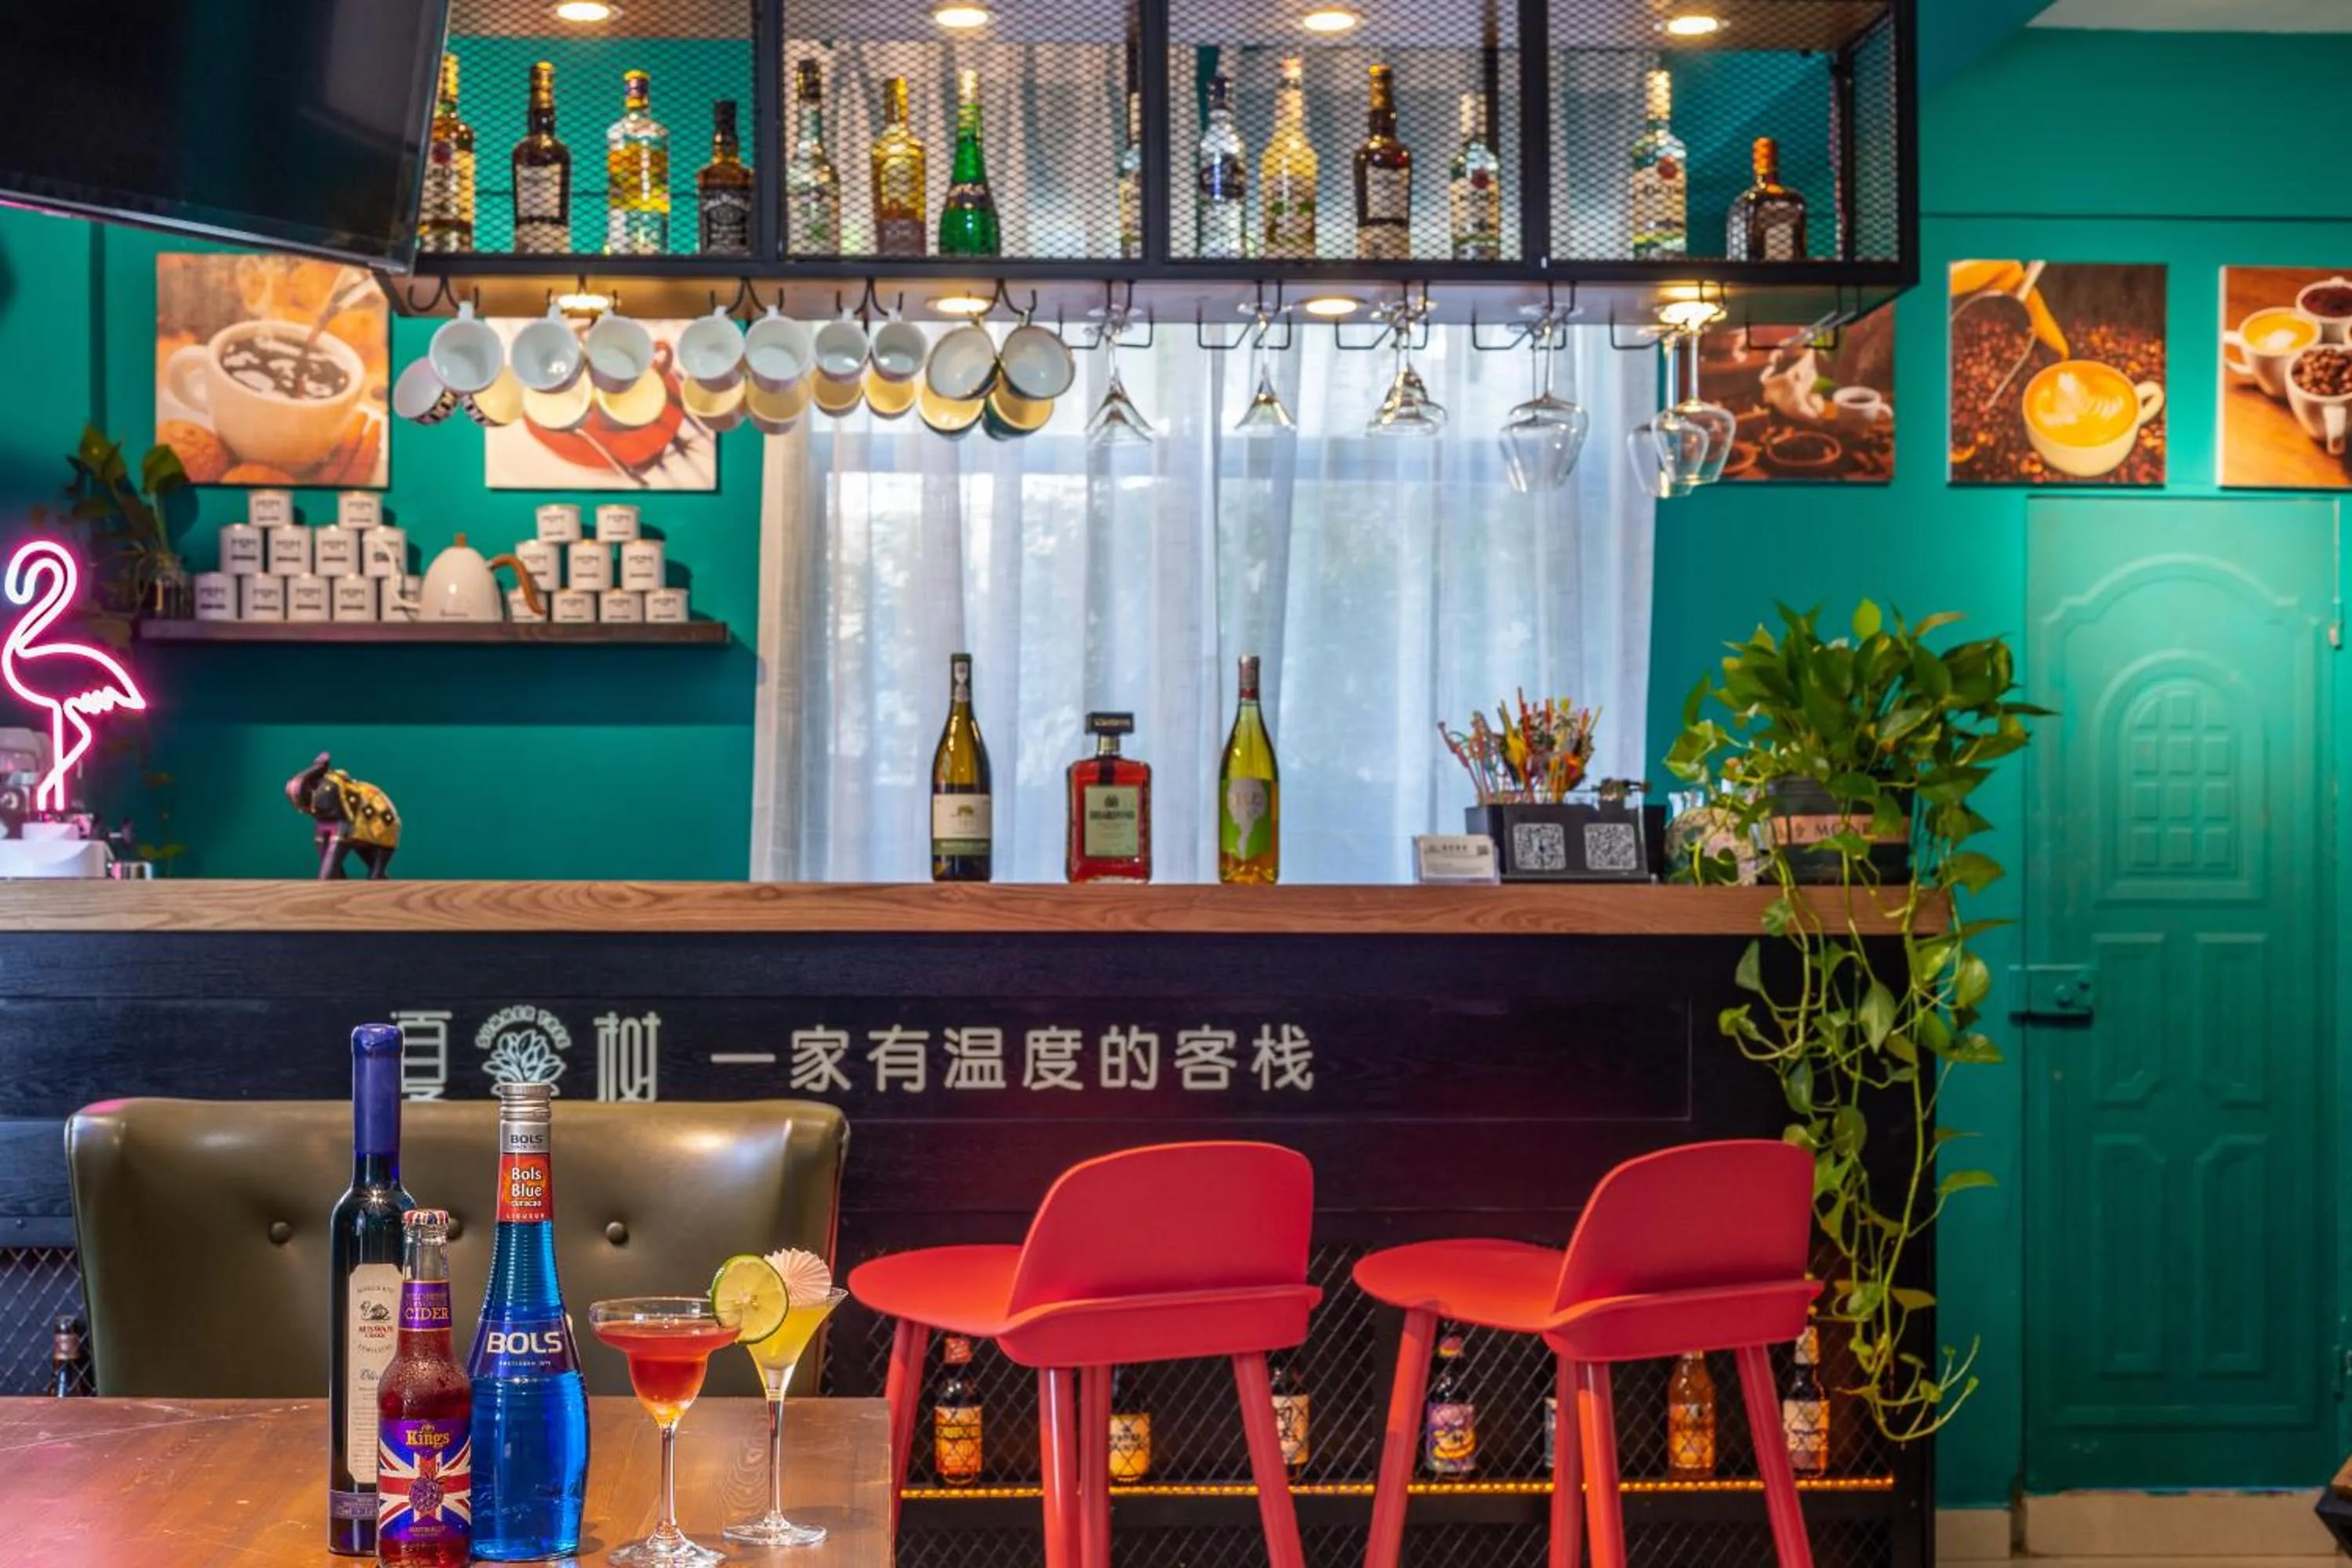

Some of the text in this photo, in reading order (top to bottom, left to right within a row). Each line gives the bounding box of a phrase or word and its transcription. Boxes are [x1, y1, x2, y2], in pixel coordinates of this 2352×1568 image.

[710, 1024, 1314, 1093] 一家有温度的客栈
[510, 1134, 543, 1144] BOLS
[512, 1167, 542, 1180] Bols
[511, 1184, 543, 1197] Blue
[404, 1307, 449, 1321] CIDER
[487, 1332, 563, 1354] BOLS
